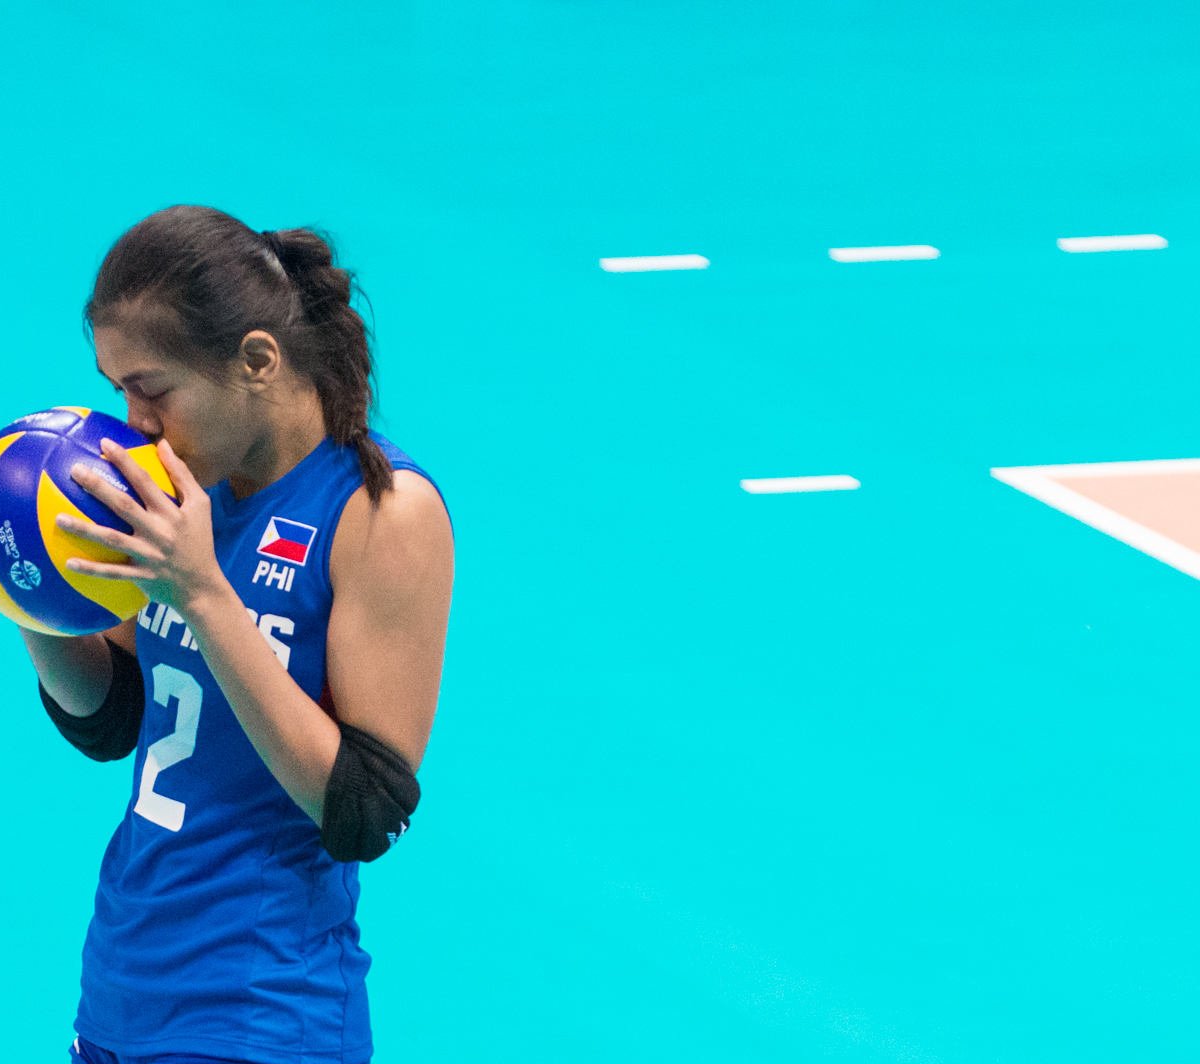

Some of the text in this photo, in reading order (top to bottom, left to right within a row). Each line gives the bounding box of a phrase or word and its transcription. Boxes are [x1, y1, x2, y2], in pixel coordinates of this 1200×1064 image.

[91, 466, 129, 492] APPROVED
[4, 526, 20, 559] GAMES
[252, 560, 296, 592] PHI
[133, 663, 203, 832] 2
